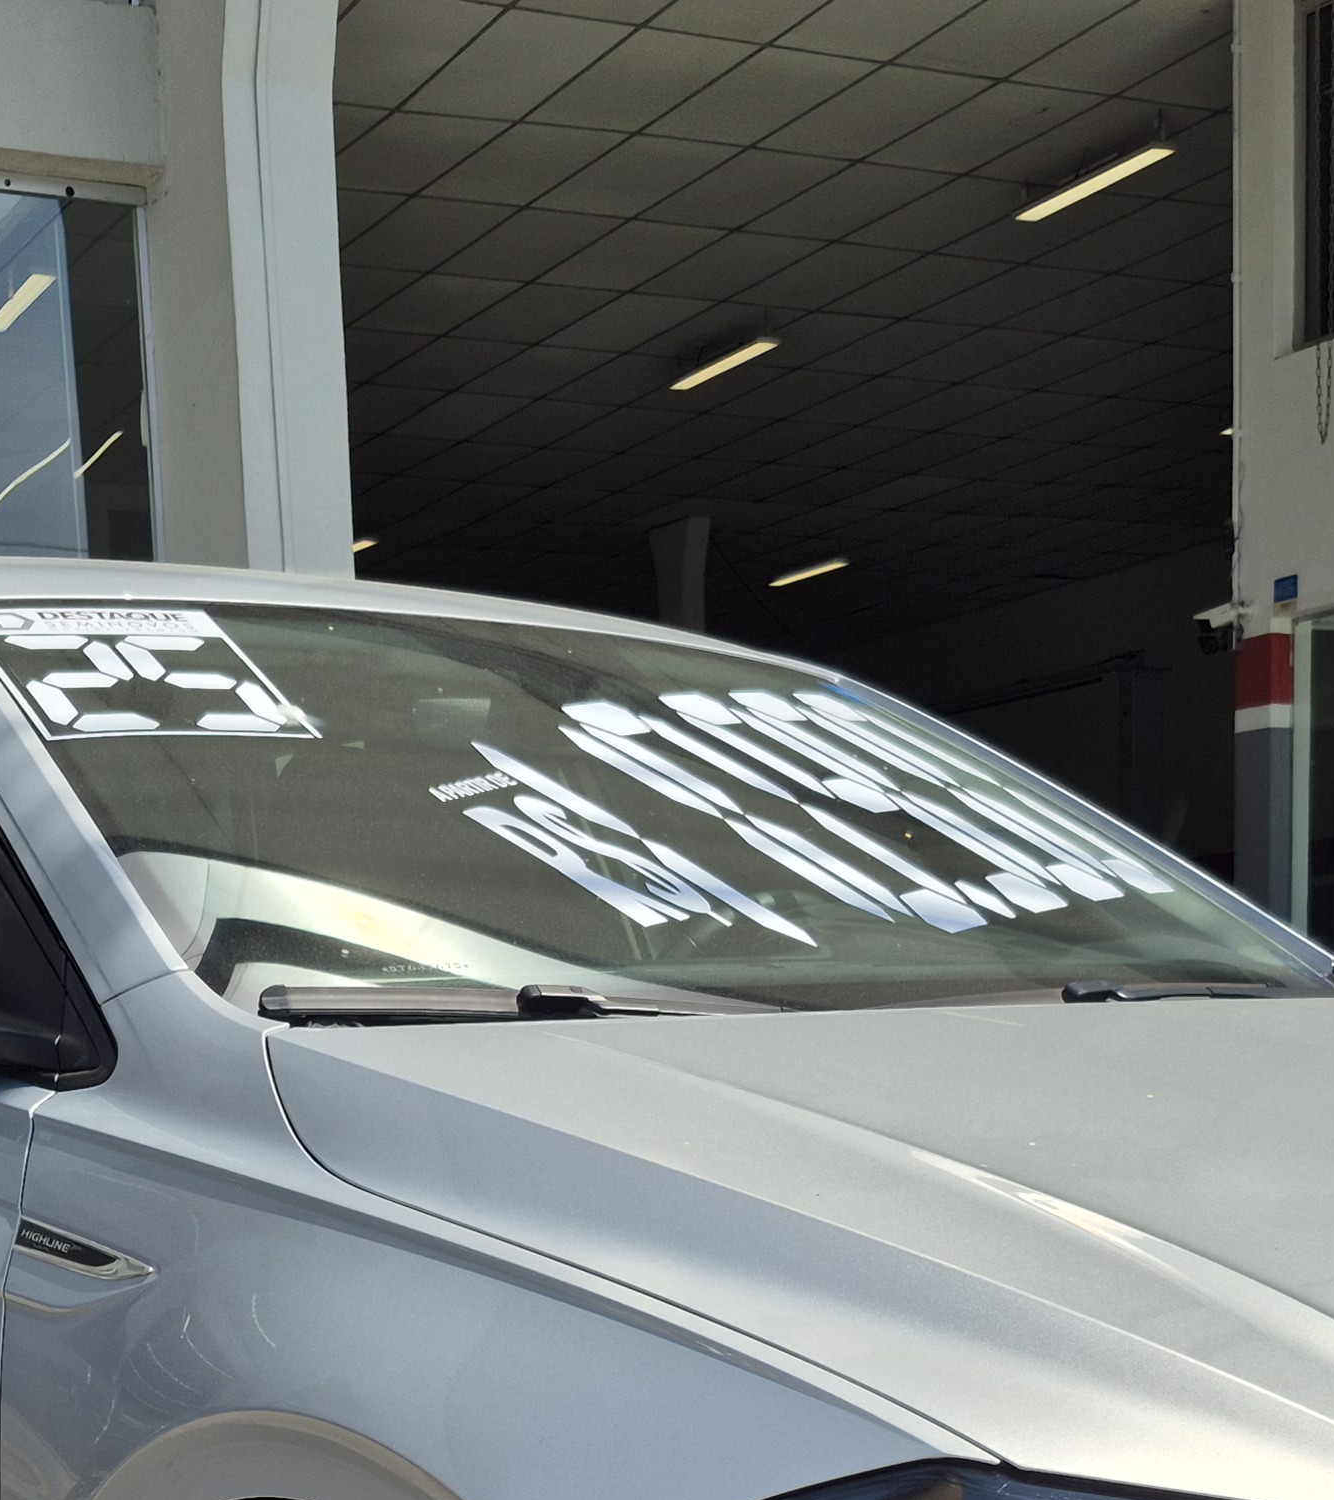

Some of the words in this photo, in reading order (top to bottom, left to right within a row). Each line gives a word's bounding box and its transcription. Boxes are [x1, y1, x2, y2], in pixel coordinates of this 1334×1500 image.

[37, 611, 190, 623] DESTAQUE
[44, 620, 196, 631] SEMINOVOS
[3, 635, 288, 732] 25
[438, 776, 500, 800] PARTIR
[485, 771, 519, 788] DE
[20, 1229, 71, 1254] HIGHLINE
